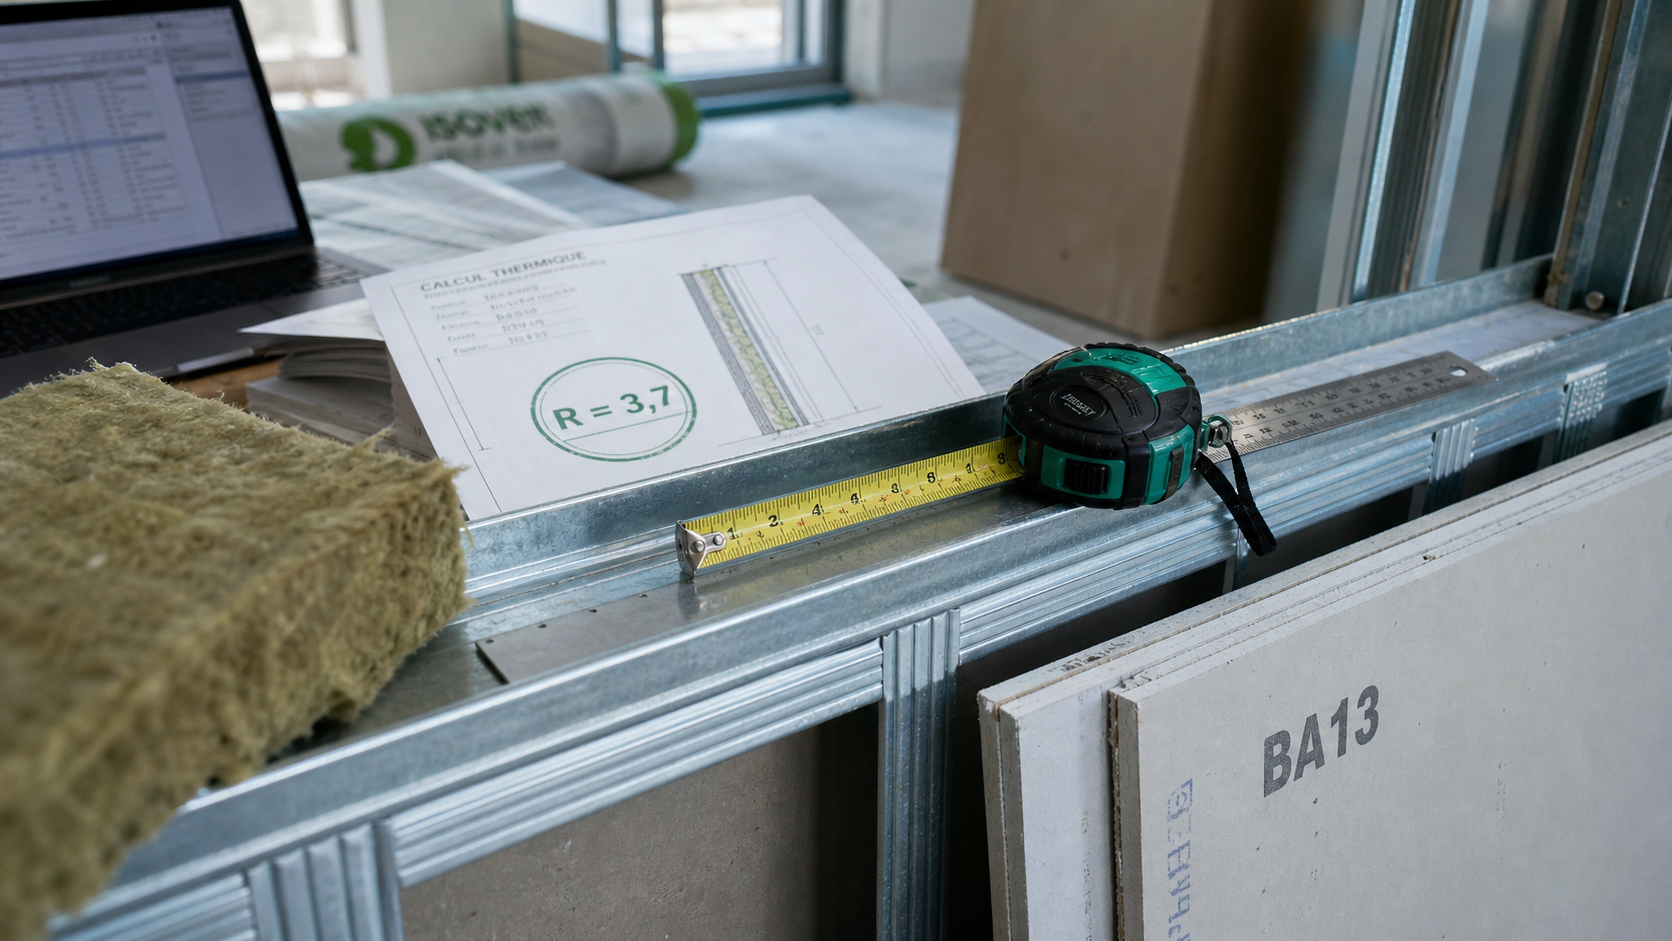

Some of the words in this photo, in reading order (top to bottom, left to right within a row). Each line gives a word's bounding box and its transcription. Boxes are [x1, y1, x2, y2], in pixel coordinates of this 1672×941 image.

[420, 273, 488, 292] CALCUL
[490, 251, 586, 278] THERMIQUE
[552, 407, 584, 430] R
[590, 405, 613, 418] =
[620, 385, 669, 414] 3,7
[768, 514, 779, 527] 2
[1264, 685, 1379, 798] BA13
